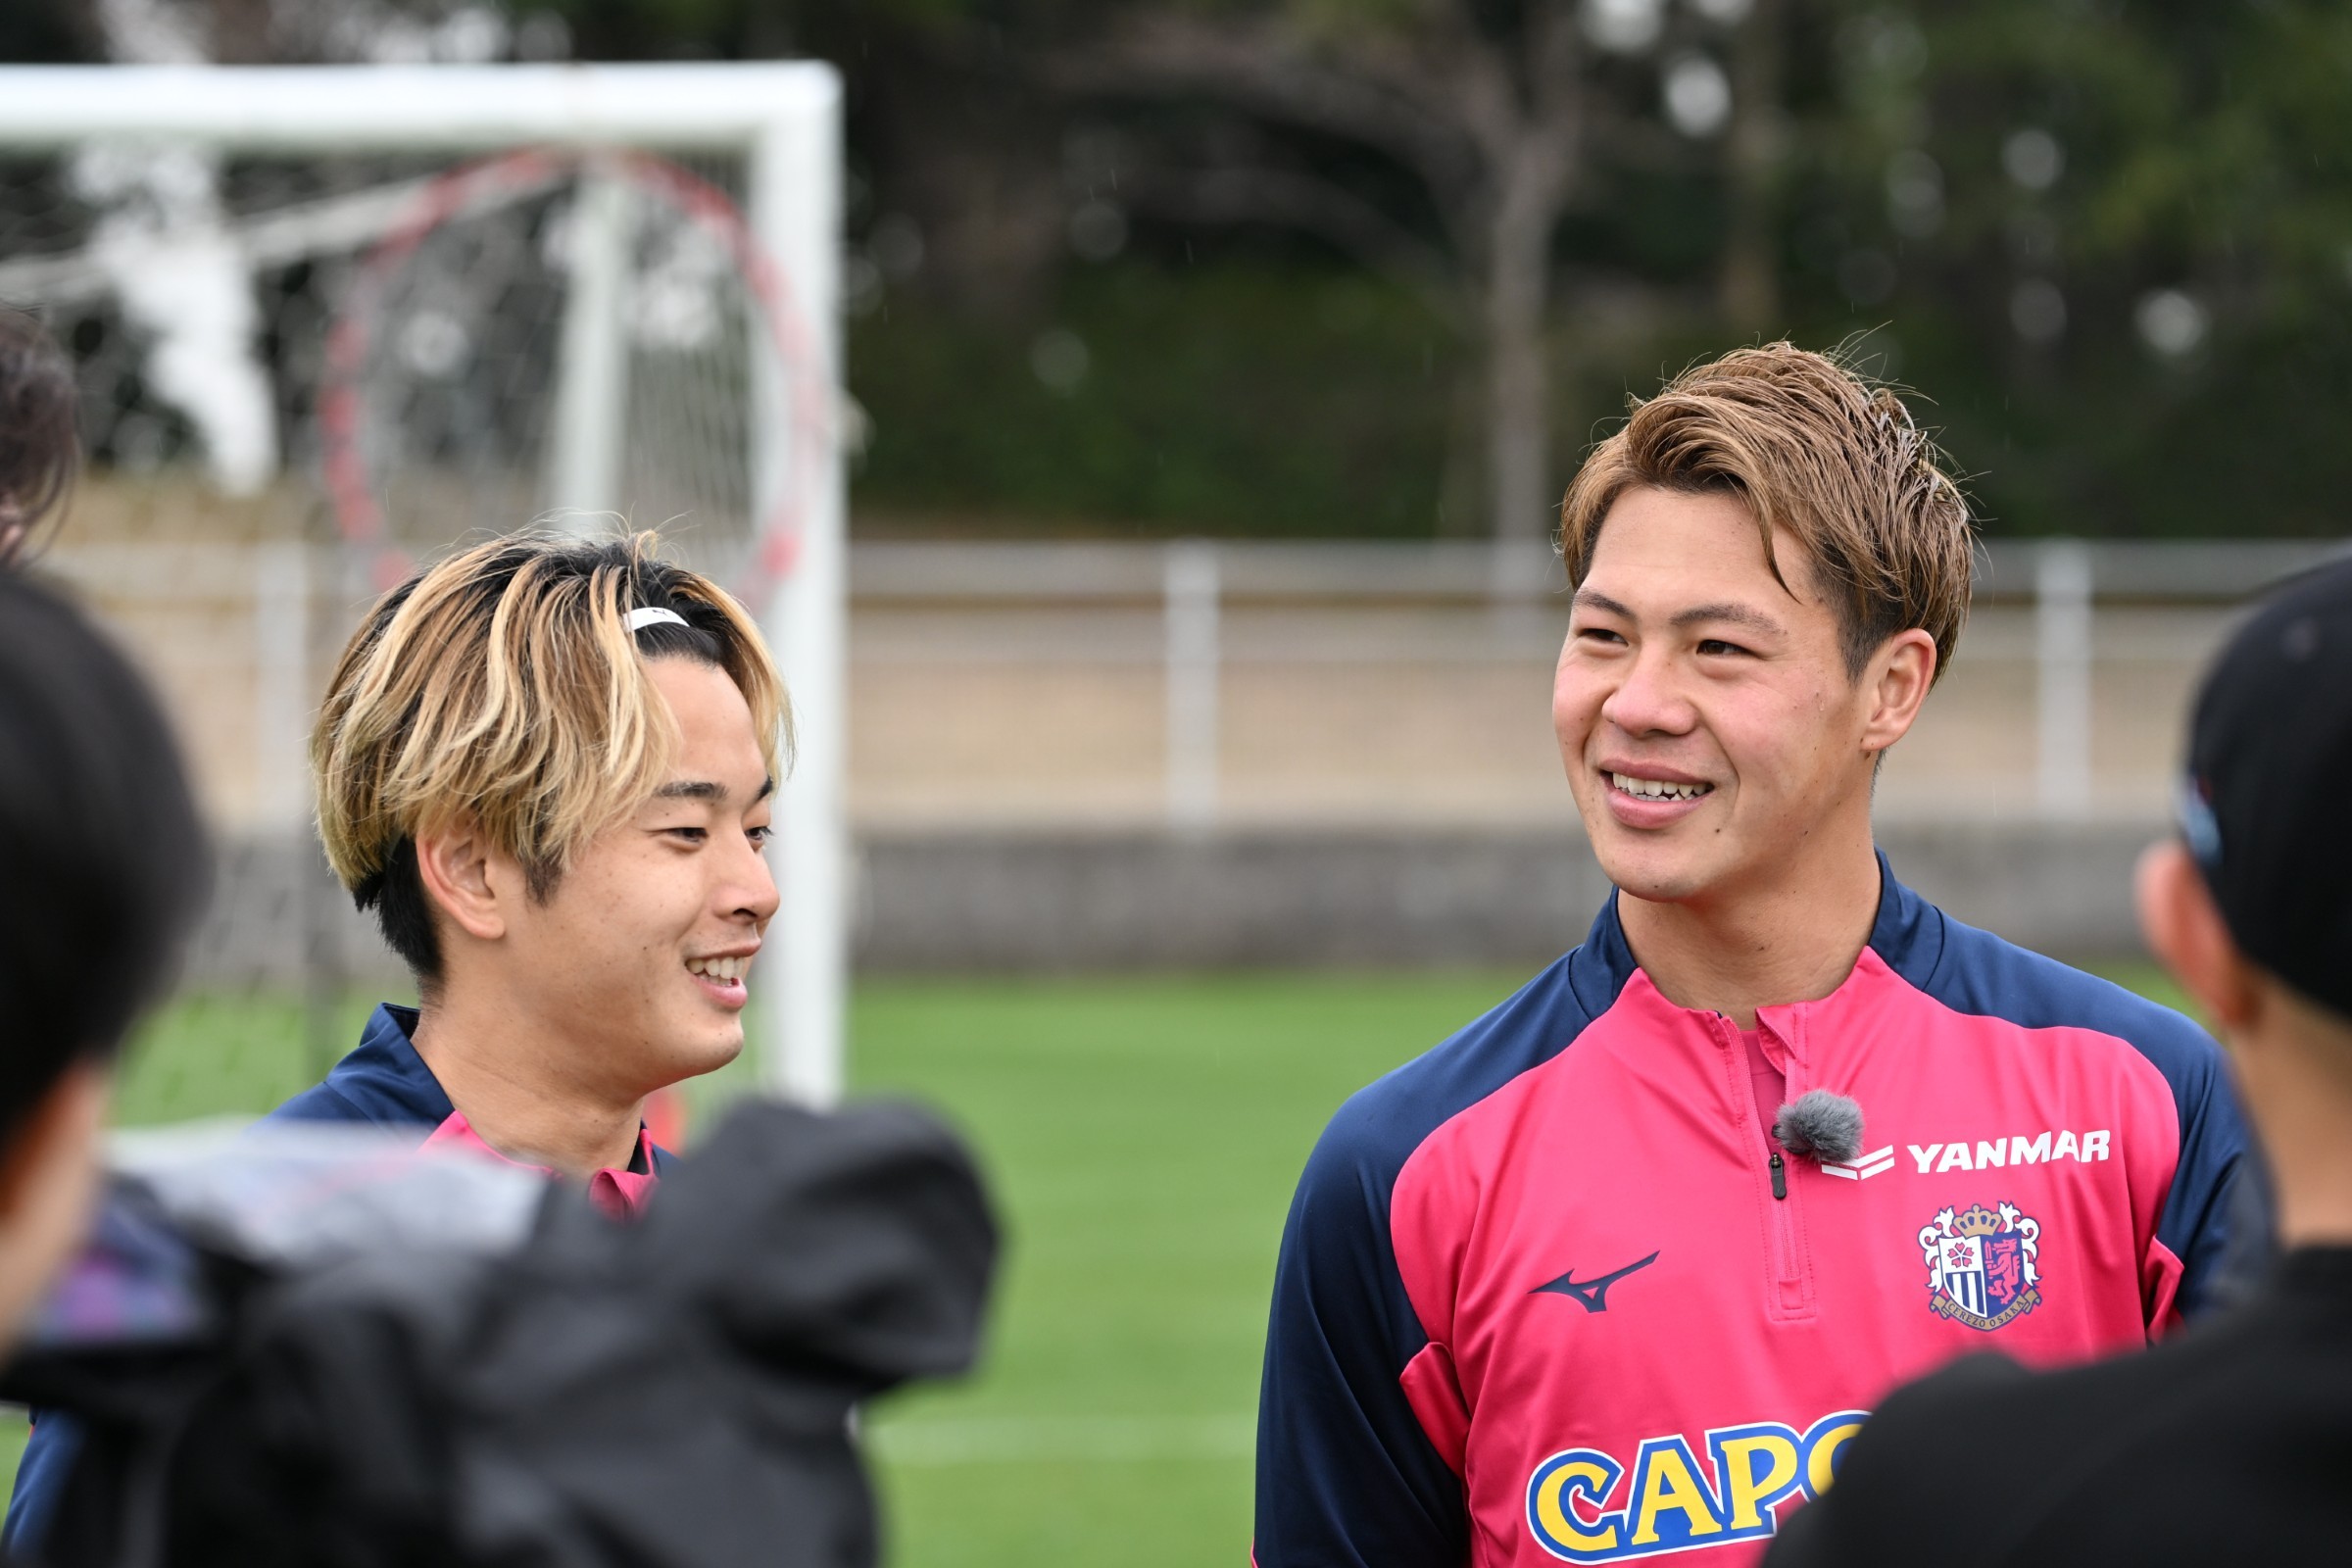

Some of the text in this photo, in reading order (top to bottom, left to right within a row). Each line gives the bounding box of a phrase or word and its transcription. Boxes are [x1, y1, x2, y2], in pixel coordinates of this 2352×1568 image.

[1906, 1129, 2111, 1174] YANMAR
[1947, 1298, 2026, 1328] CEREZO OSAKA
